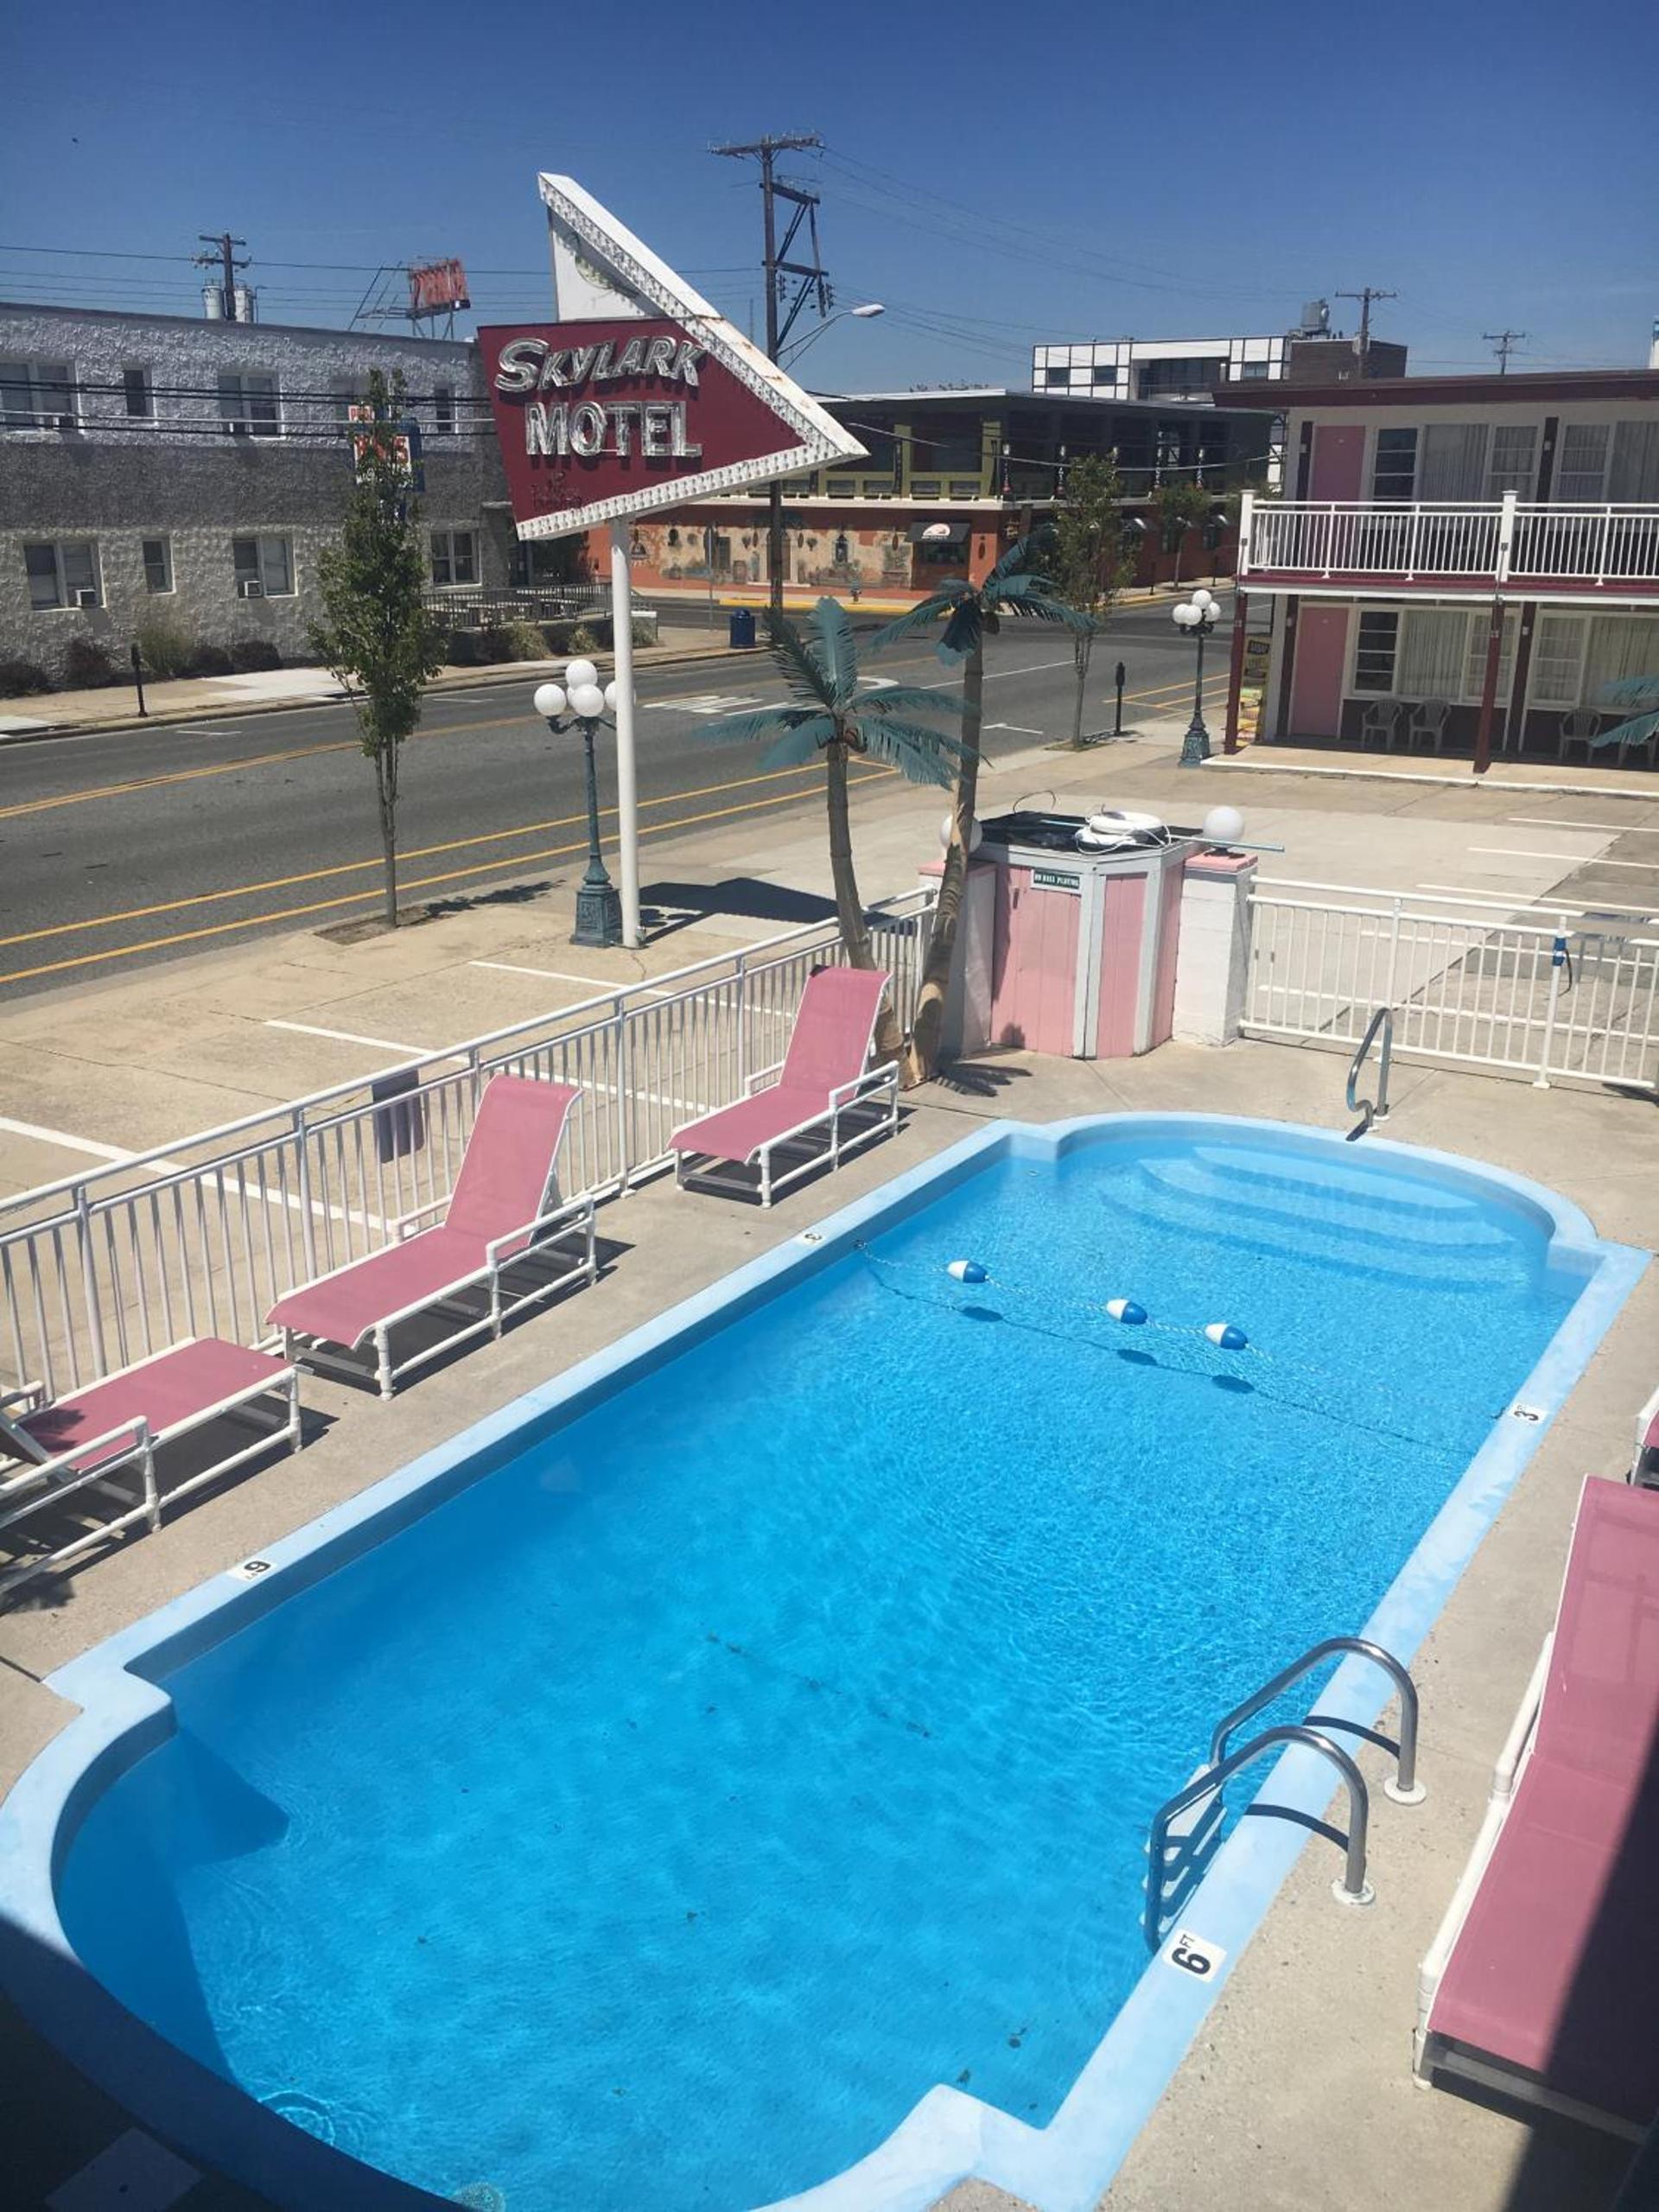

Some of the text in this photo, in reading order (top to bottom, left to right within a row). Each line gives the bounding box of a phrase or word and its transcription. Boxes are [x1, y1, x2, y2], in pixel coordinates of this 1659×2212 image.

[494, 336, 707, 392] SKYLARK
[524, 400, 702, 457] MOTEL
[1514, 1410, 1539, 1421] 3
[1172, 1934, 1211, 1975] 6 FT
